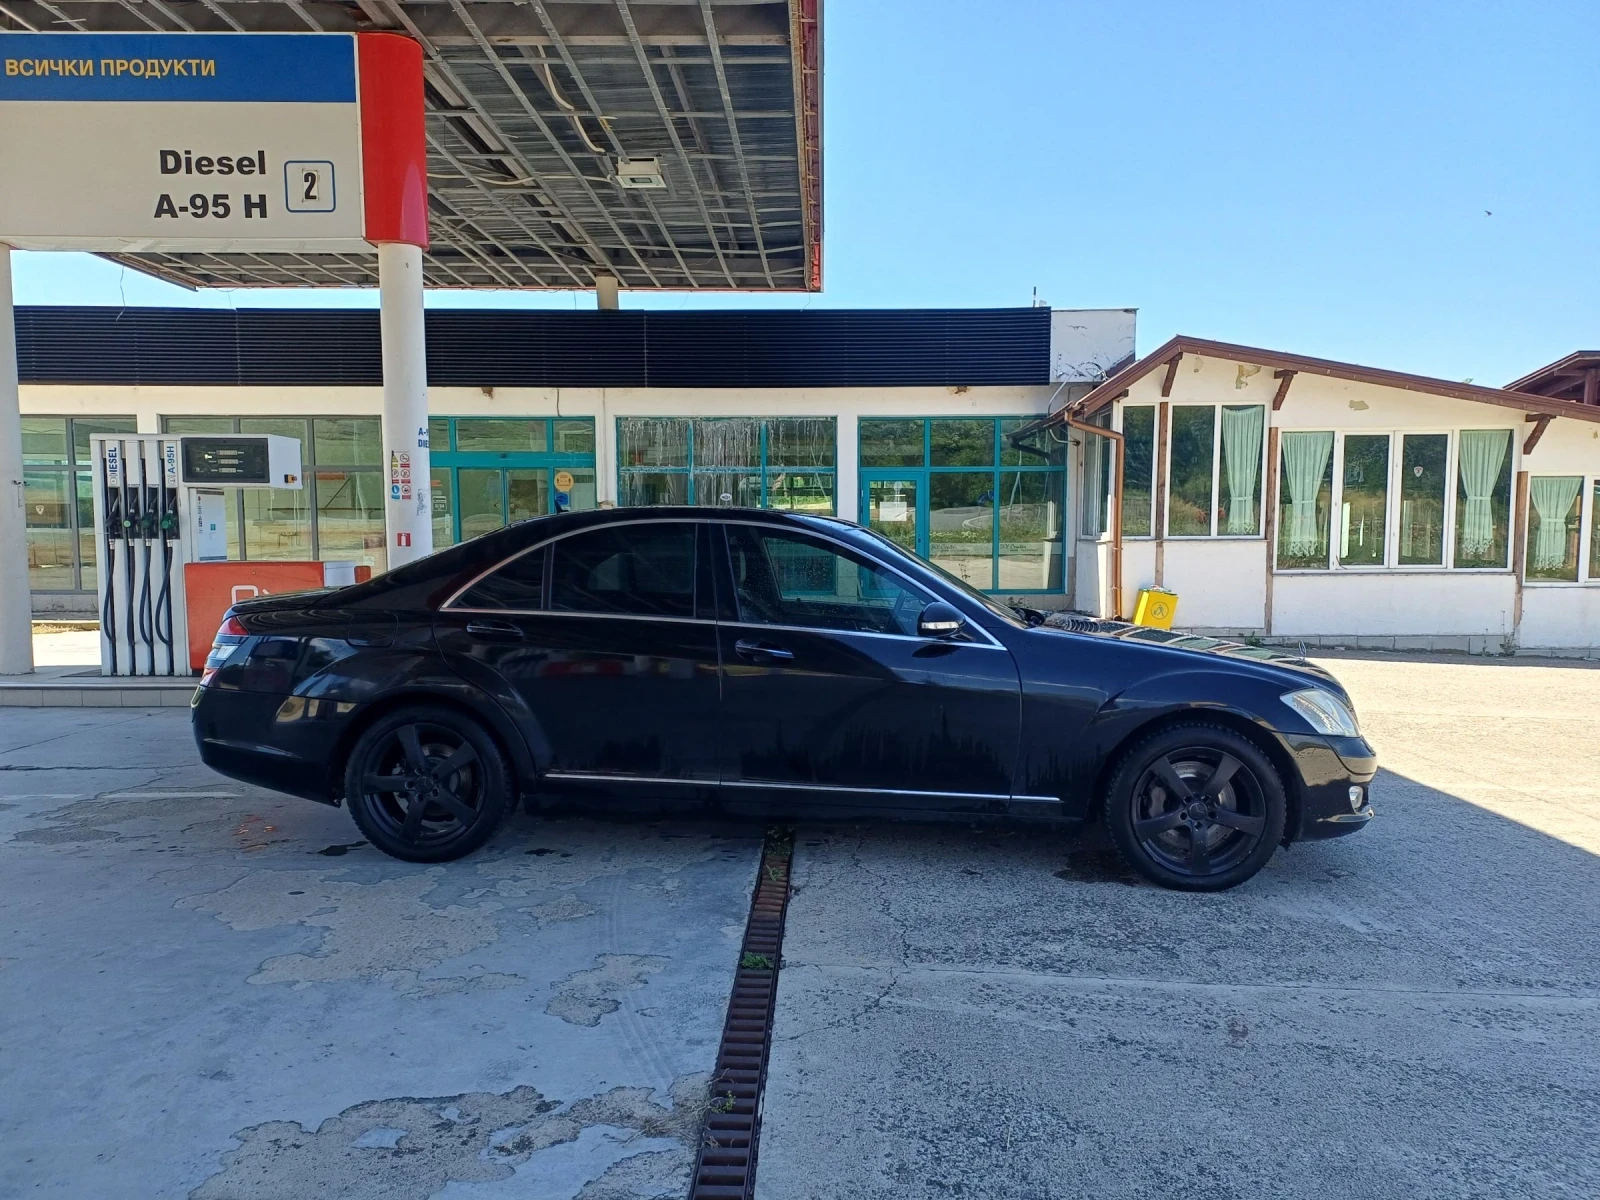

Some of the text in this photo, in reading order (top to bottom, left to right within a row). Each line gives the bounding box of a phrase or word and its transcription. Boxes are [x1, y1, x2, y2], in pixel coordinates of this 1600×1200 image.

[5, 58, 216, 79] ВСИЧКИ ПРОДУКТИ
[159, 149, 266, 176] Diesel
[303, 172, 318, 201] 2
[153, 194, 231, 219] A-95
[418, 439, 430, 448] DIE
